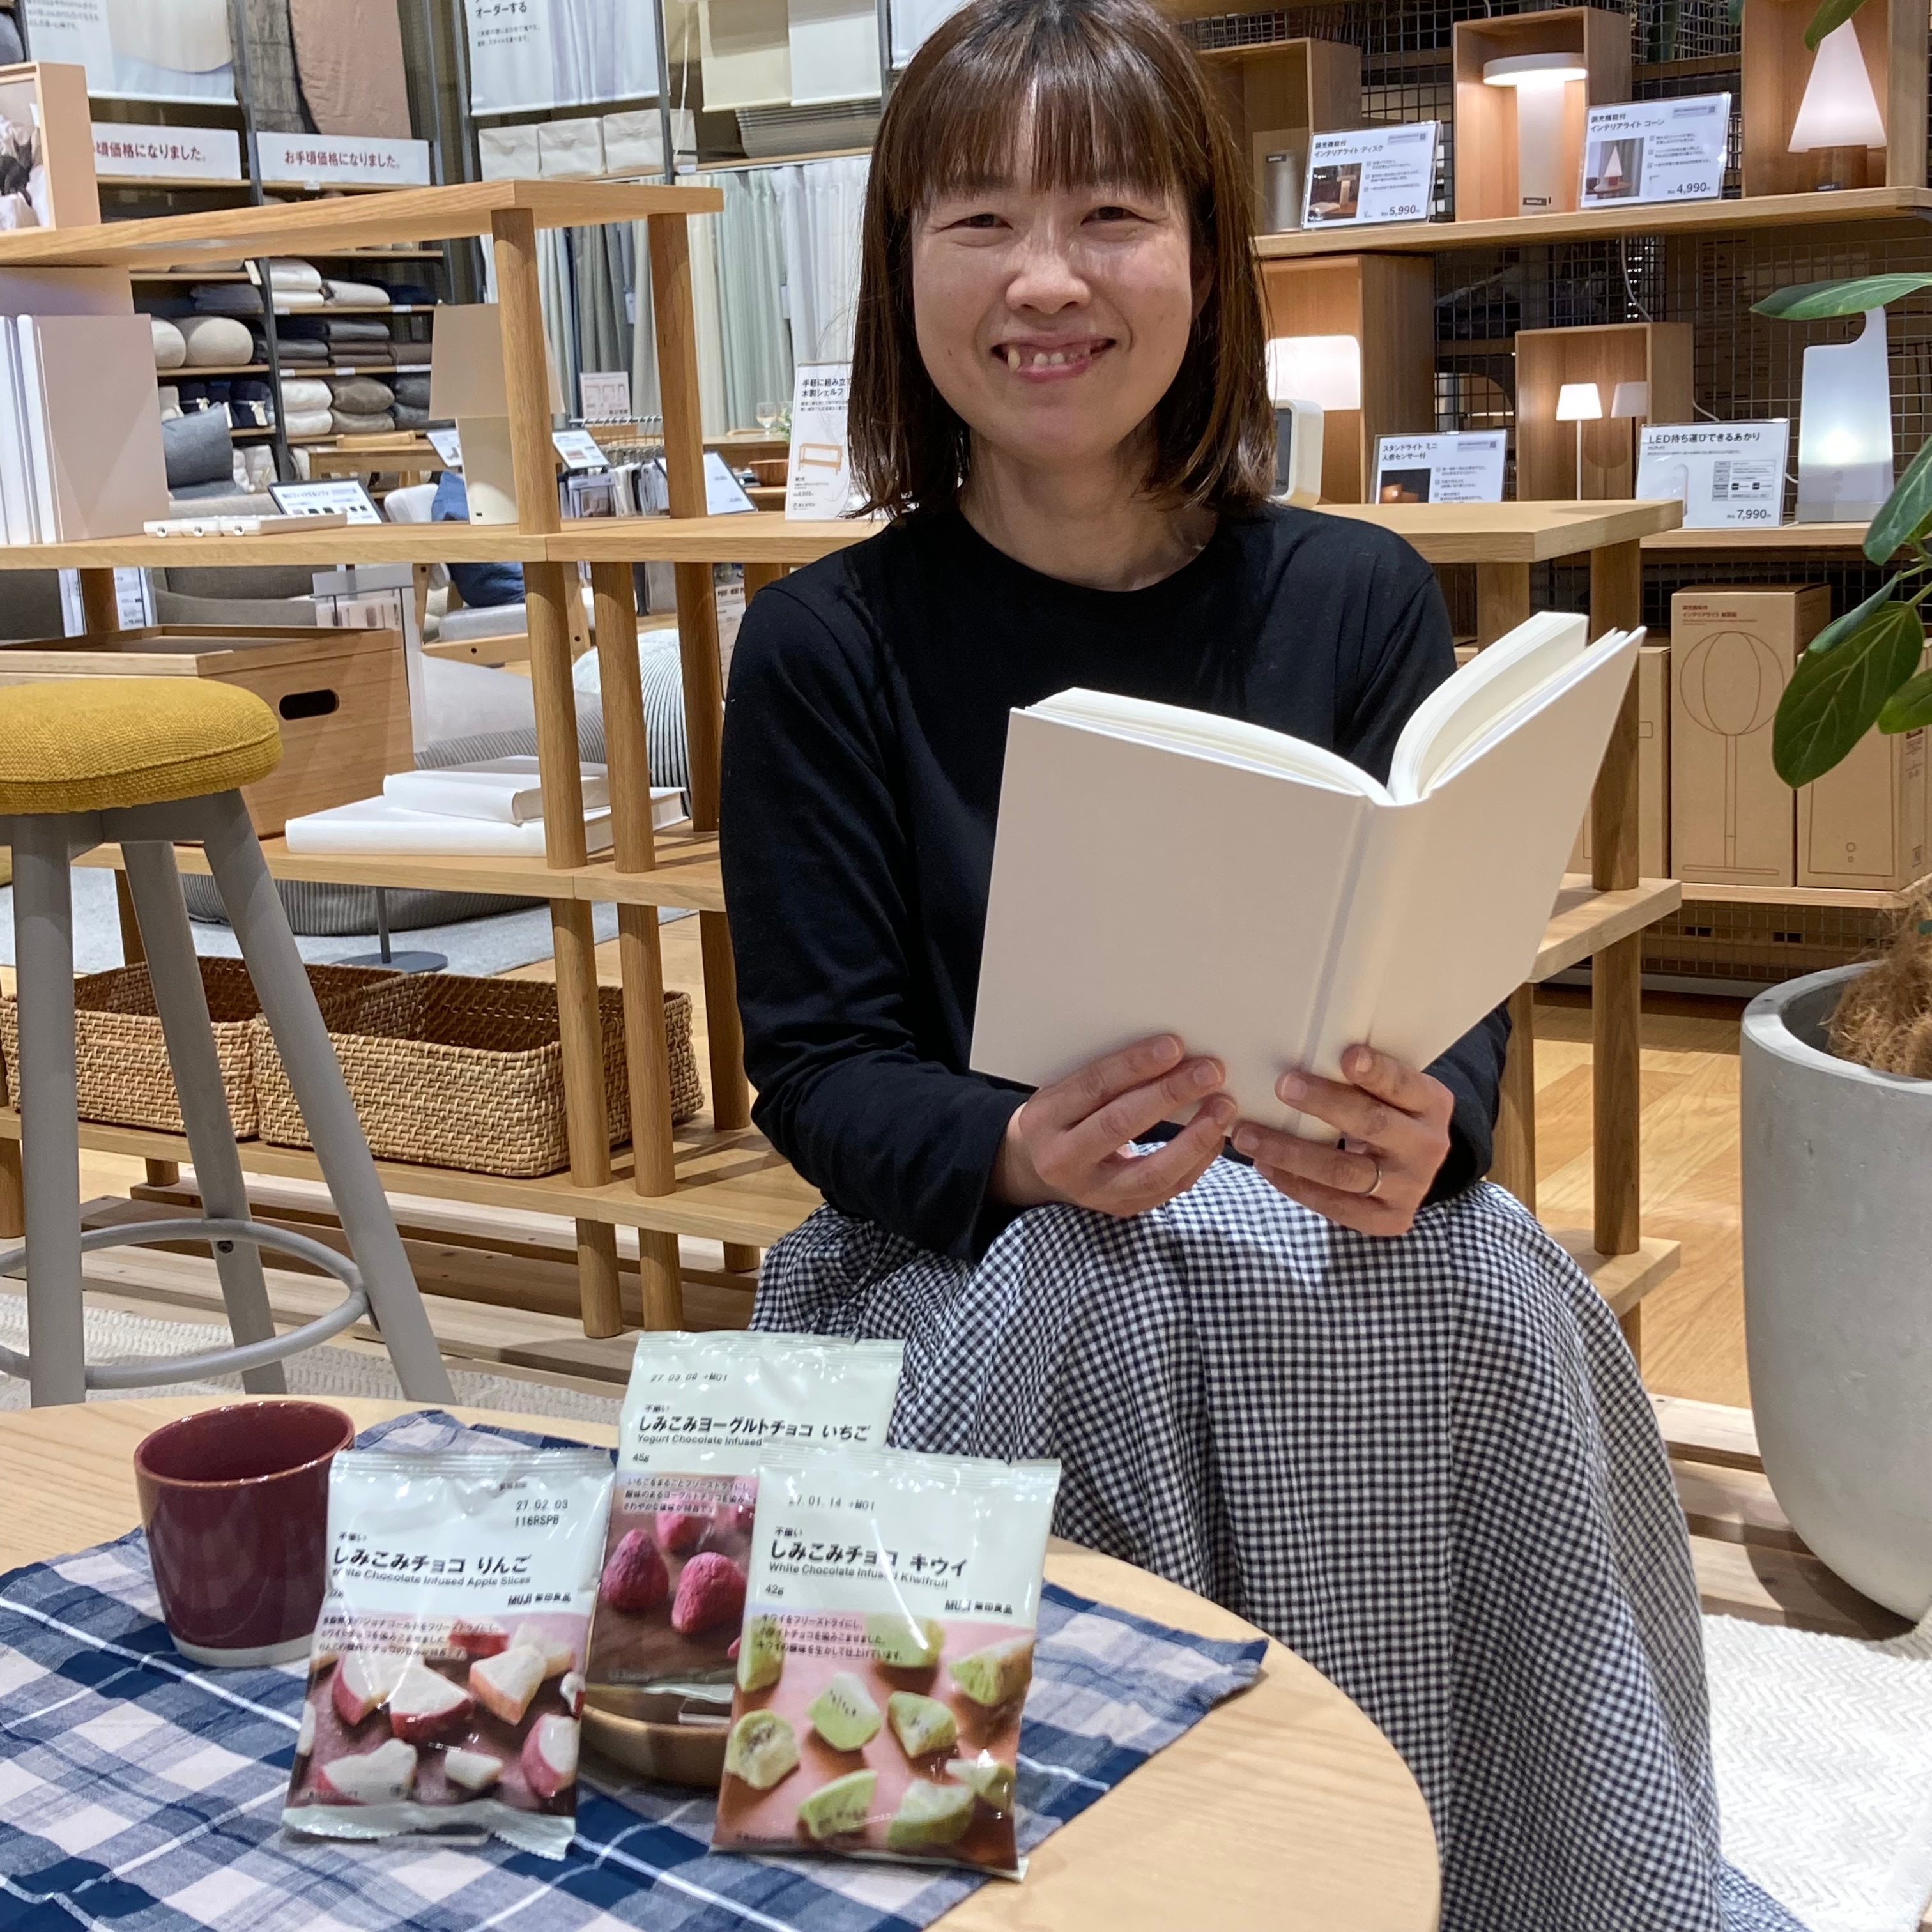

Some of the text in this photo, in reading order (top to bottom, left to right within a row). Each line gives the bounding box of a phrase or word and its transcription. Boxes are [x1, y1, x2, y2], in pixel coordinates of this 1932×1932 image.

[476, 2, 527, 19] オーダーする
[1590, 118, 1665, 132] インテリアライト コーン
[94, 141, 206, 162] 頃価格になりました。
[1314, 144, 1384, 158] インテリアライト ディスク
[285, 150, 400, 169] お手頃価格になりました。
[802, 388, 844, 397] 木製シェルフ
[1648, 432, 1761, 444] LED持ち運びできるあかり
[1383, 443, 1423, 452] スタンドライト
[1382, 452, 1426, 461] 人感センサー付
[639, 1415, 871, 1441] しみこみヨーグルトチョコ いちご
[637, 1433, 762, 1446] Yogurt Chocolate Infused
[632, 1452, 650, 1463] 45g
[334, 1547, 532, 1575] しみこみチョコ りんご
[771, 1540, 968, 1577] しみこみチョコ キウイ
[364, 1569, 420, 1584] Chocolate
[424, 1574, 464, 1586] Infused
[466, 1575, 497, 1590] Apple
[500, 1575, 531, 1586] Slices
[769, 1561, 949, 1588] White Chocolate Infus Kiwifruit
[765, 1584, 784, 1595] 42g
[507, 1591, 572, 1606] MUJI 無印良品
[974, 1600, 1013, 1614] 無印良品
[762, 1613, 863, 1629] キウイをフリーズドライにし、
